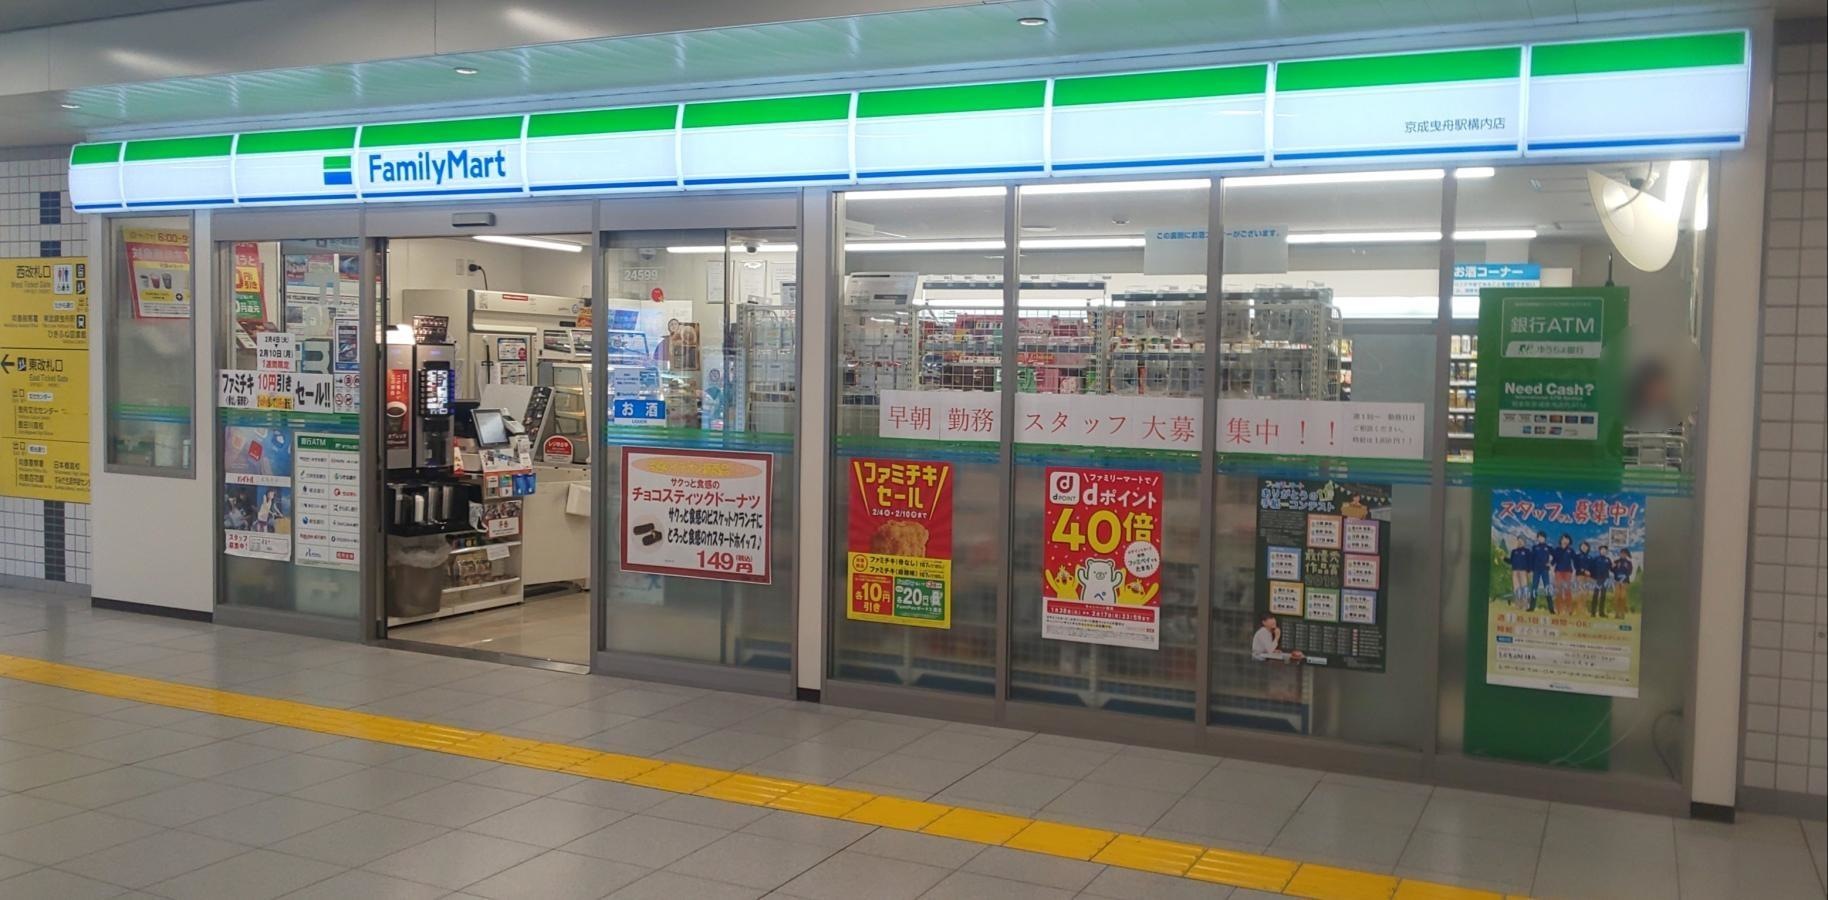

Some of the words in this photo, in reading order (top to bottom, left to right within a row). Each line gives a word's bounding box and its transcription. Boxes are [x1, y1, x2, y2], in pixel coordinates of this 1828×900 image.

[369, 149, 506, 185] FamilyMart
[16, 265, 51, 279] 西改札口
[624, 269, 658, 280] 24599
[1453, 265, 1524, 278] お酒コーナー
[1510, 316, 1595, 334] 銀行ATM
[1537, 345, 1584, 354] ゆうちょ銀行
[29, 358, 63, 372] 東改札口
[222, 373, 255, 395] ファミチキ
[258, 373, 292, 393] 10円引き
[1505, 382, 1542, 394] Need
[1546, 383, 1594, 396] Cash?
[295, 380, 331, 408] セール!!
[622, 401, 658, 417] お酒
[888, 406, 932, 432] 早朝
[948, 407, 995, 433] 勤務
[1024, 410, 1127, 434] スタッフ
[1142, 414, 1197, 442] 大募
[670, 478, 720, 489] サクっと食感の
[863, 461, 937, 487] ファミチキ
[1088, 473, 1153, 484] ファミリーマートで
[632, 487, 761, 509] チョコスティックドーナツ
[876, 485, 924, 509] セール
[1082, 483, 1158, 509] dポイント
[668, 507, 764, 529] サクっと食感のビスケットクランチに
[229, 534, 248, 542] スタッフ
[1051, 508, 1155, 554] 40倍
[696, 550, 734, 570] 149
[735, 563, 753, 574] 円
[855, 582, 892, 603] 各10円
[863, 602, 881, 613] 引き
